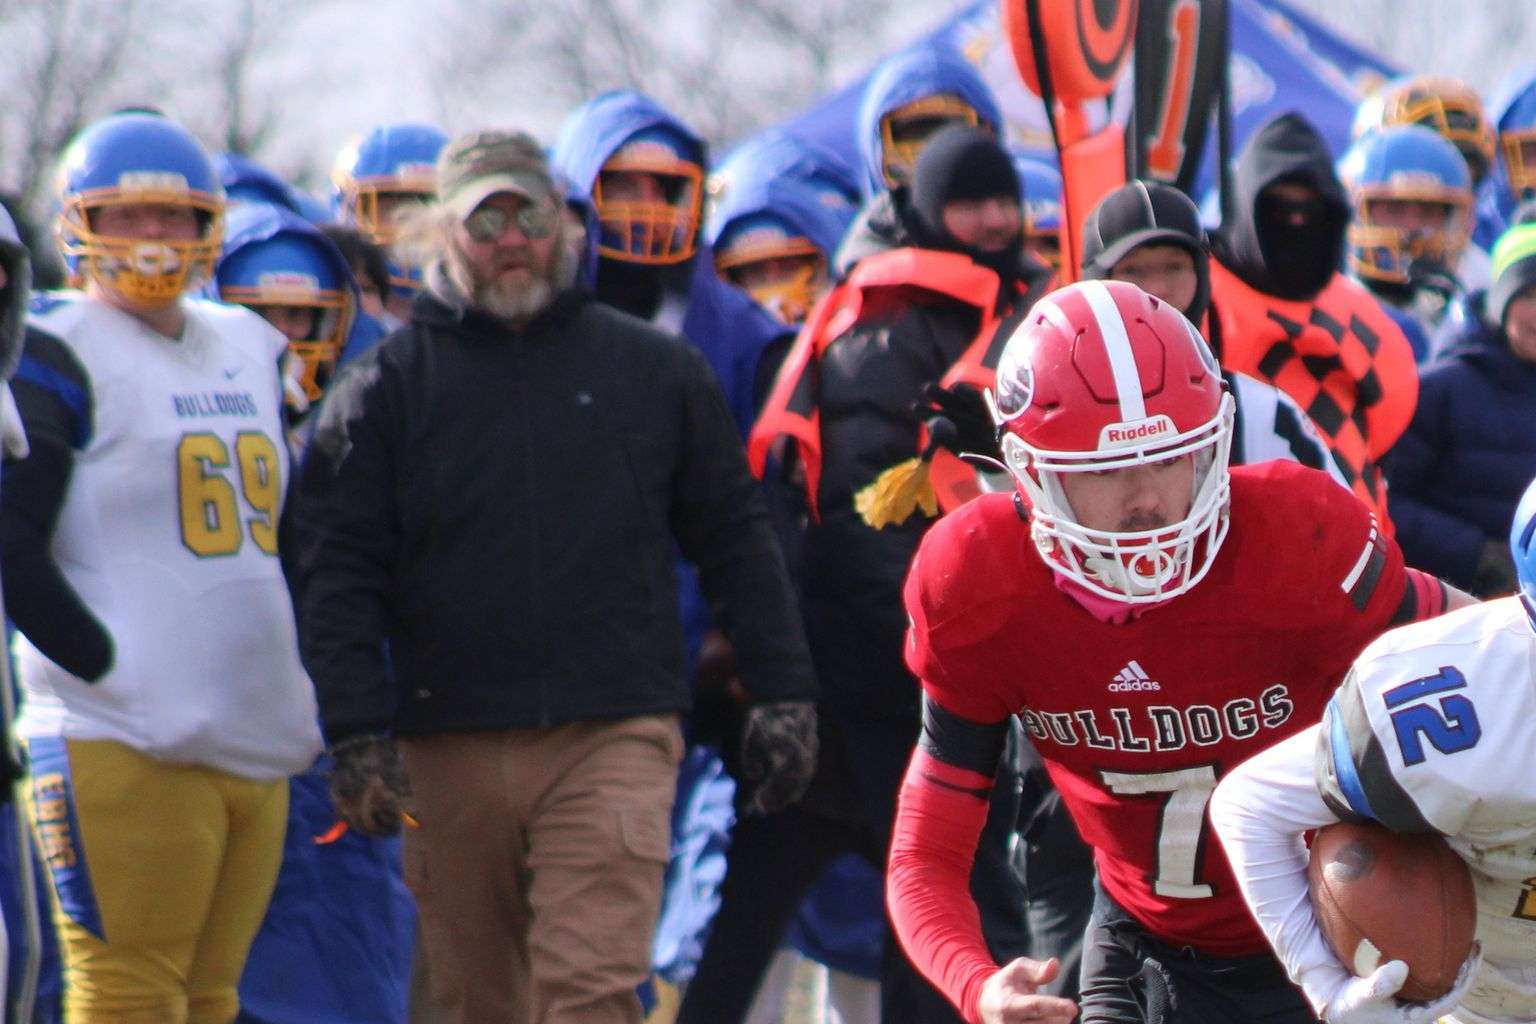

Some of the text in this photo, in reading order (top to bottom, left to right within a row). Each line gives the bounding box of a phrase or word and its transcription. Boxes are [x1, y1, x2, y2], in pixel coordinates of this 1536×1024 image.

[1147, 3, 1200, 181] 1
[173, 393, 259, 418] BULLDOGS
[1108, 420, 1167, 441] Riddell
[177, 430, 281, 558] 69
[1108, 680, 1161, 692] adidas
[1382, 665, 1482, 768] 12
[1097, 763, 1218, 899] 7
